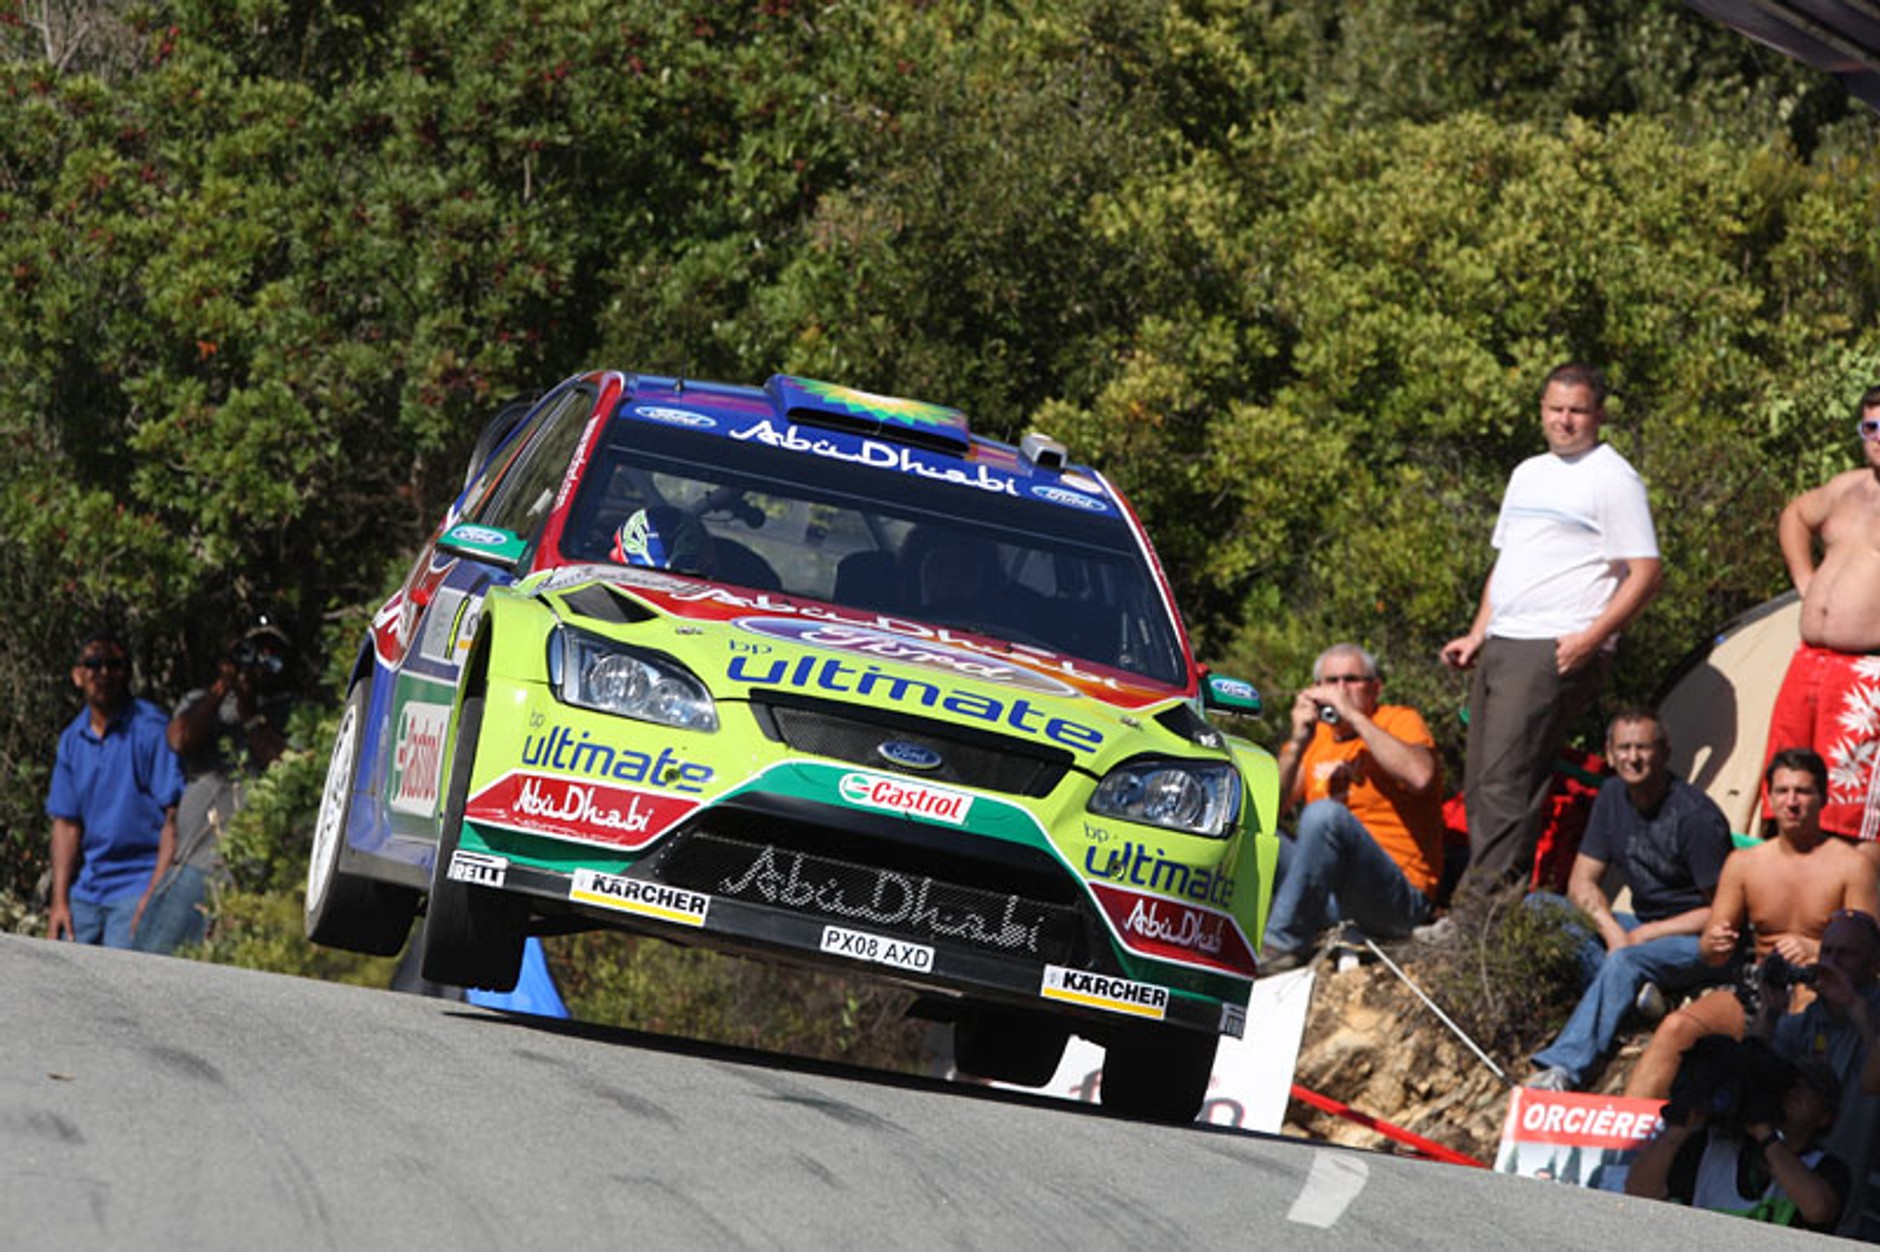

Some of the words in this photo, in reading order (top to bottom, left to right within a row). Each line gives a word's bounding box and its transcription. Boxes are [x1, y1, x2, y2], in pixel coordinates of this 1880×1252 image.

[726, 655, 1104, 754] ultimate
[521, 726, 714, 794] ultimate
[870, 778, 965, 820] Castrol
[1084, 841, 1236, 909] ultimate
[824, 929, 879, 958] PX08
[883, 944, 931, 969] AXD
